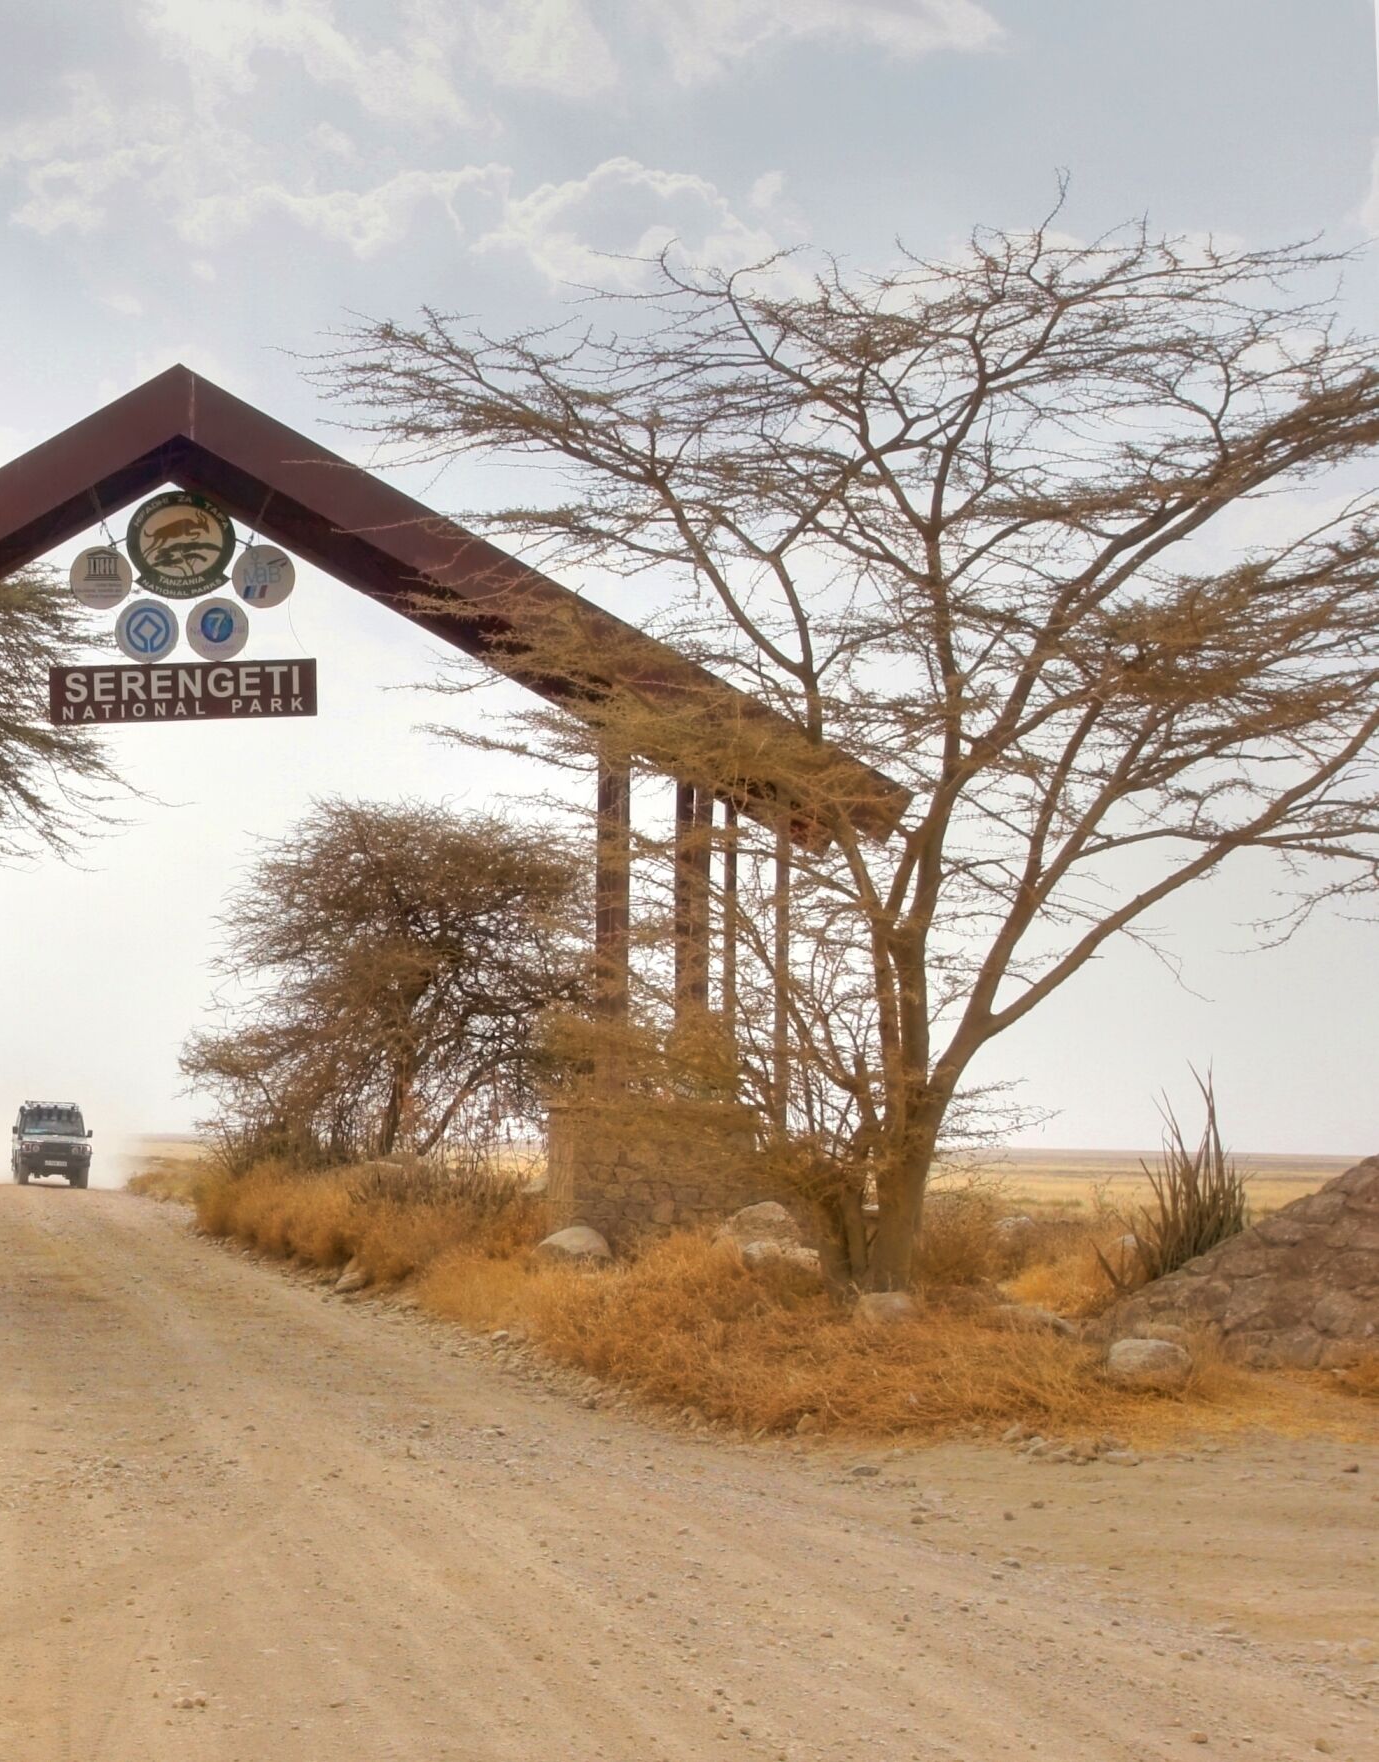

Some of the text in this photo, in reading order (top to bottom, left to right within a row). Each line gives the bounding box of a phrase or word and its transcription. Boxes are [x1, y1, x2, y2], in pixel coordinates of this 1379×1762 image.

[205, 501, 229, 530] TAIFA
[142, 579, 222, 596] NATIONAL PARKS
[159, 575, 205, 586] TANZANIA
[65, 665, 300, 703] SERENGETI
[62, 697, 304, 721] NATIONAL PARK
